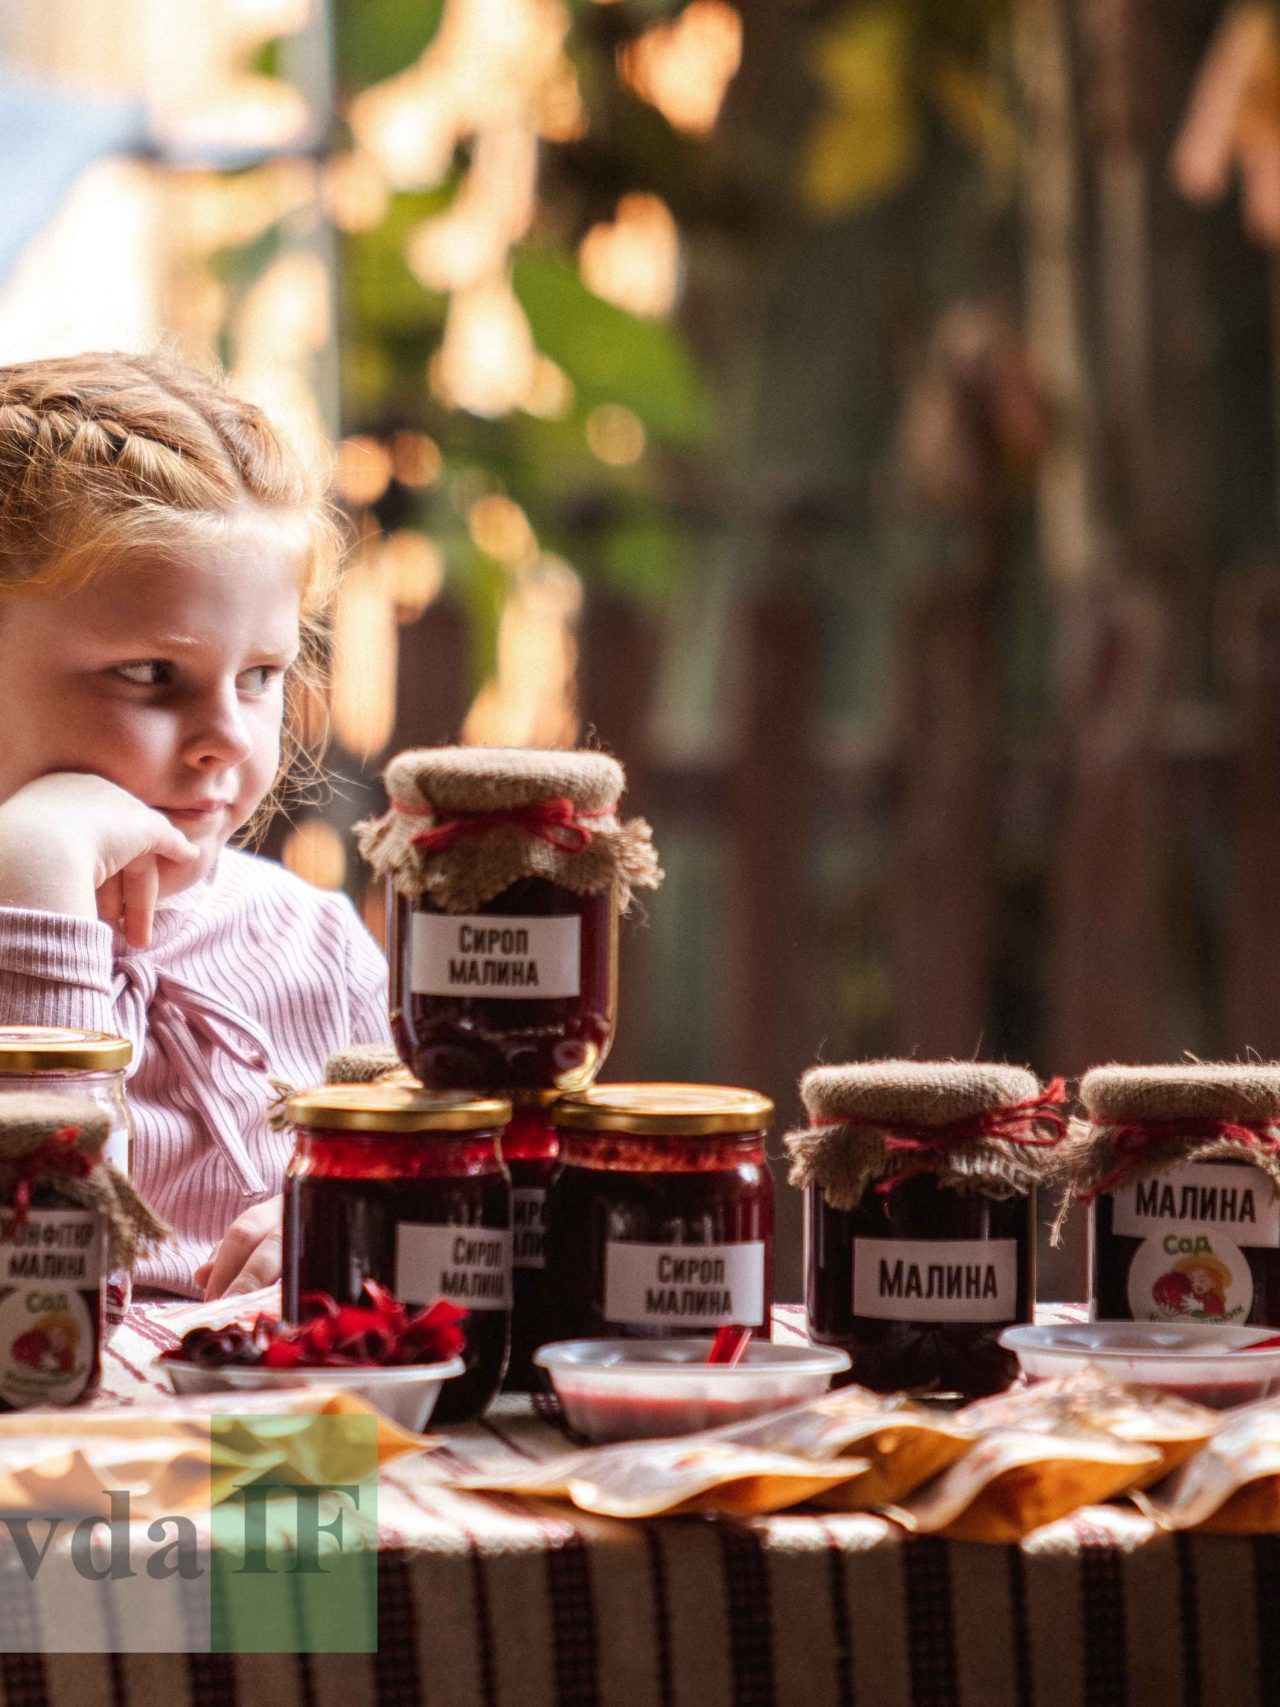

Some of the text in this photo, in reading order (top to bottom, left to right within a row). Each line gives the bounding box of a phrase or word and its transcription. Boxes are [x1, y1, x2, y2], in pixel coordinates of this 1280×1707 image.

[449, 959, 539, 986] МАЛИНА
[1135, 1180, 1256, 1223] МАЛИНА
[880, 1259, 998, 1299] МАЛИНА
[646, 1288, 733, 1315] МАЛИНА
